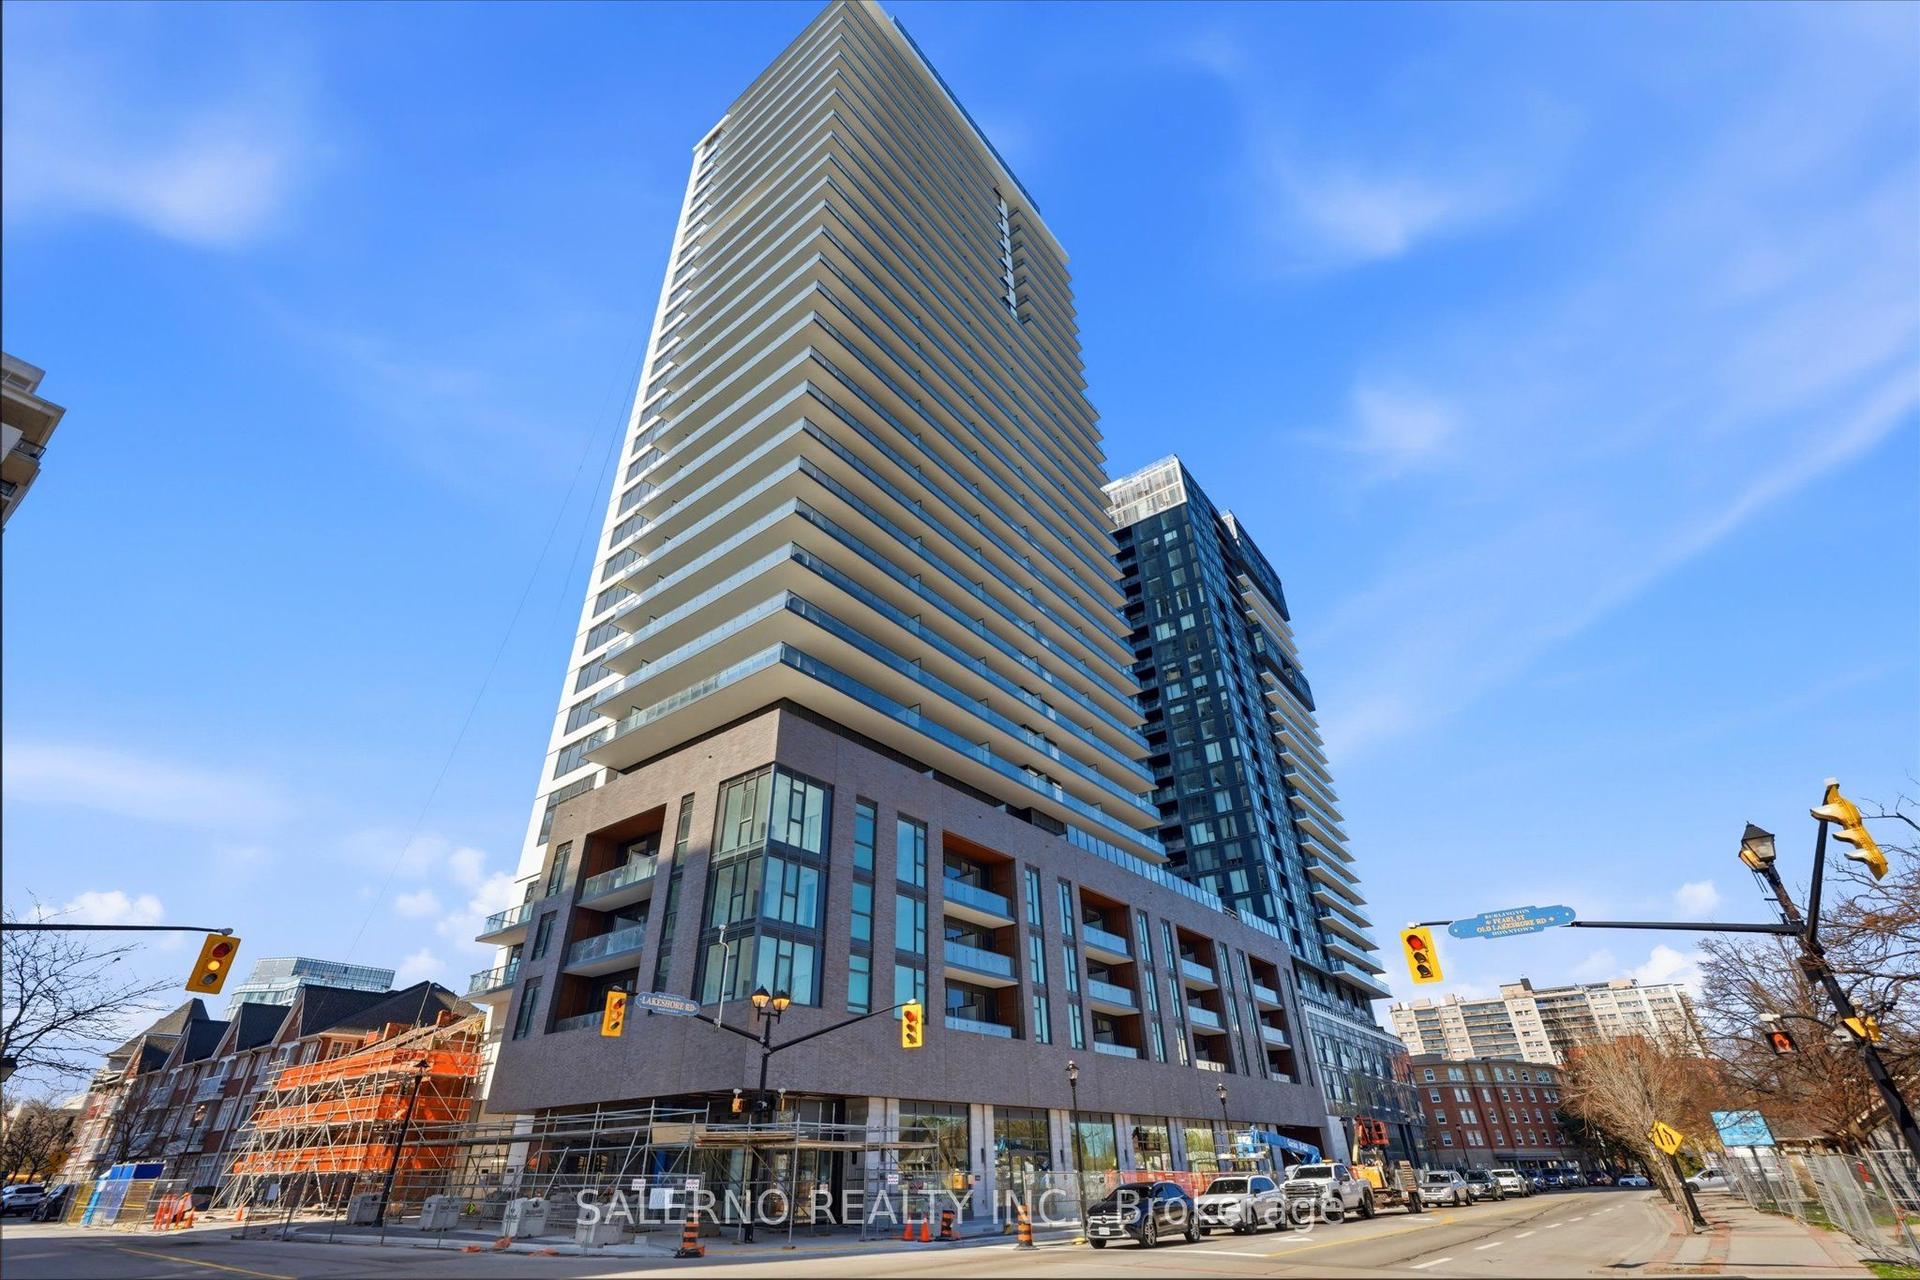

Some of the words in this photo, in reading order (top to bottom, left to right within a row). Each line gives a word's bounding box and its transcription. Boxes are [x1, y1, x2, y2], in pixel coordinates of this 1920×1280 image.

[1492, 920, 1534, 931] LAKESHORE
[1492, 926, 1535, 936] DOWNTOWN
[641, 996, 686, 1010] LAKESHORE
[685, 1003, 696, 1012] RD
